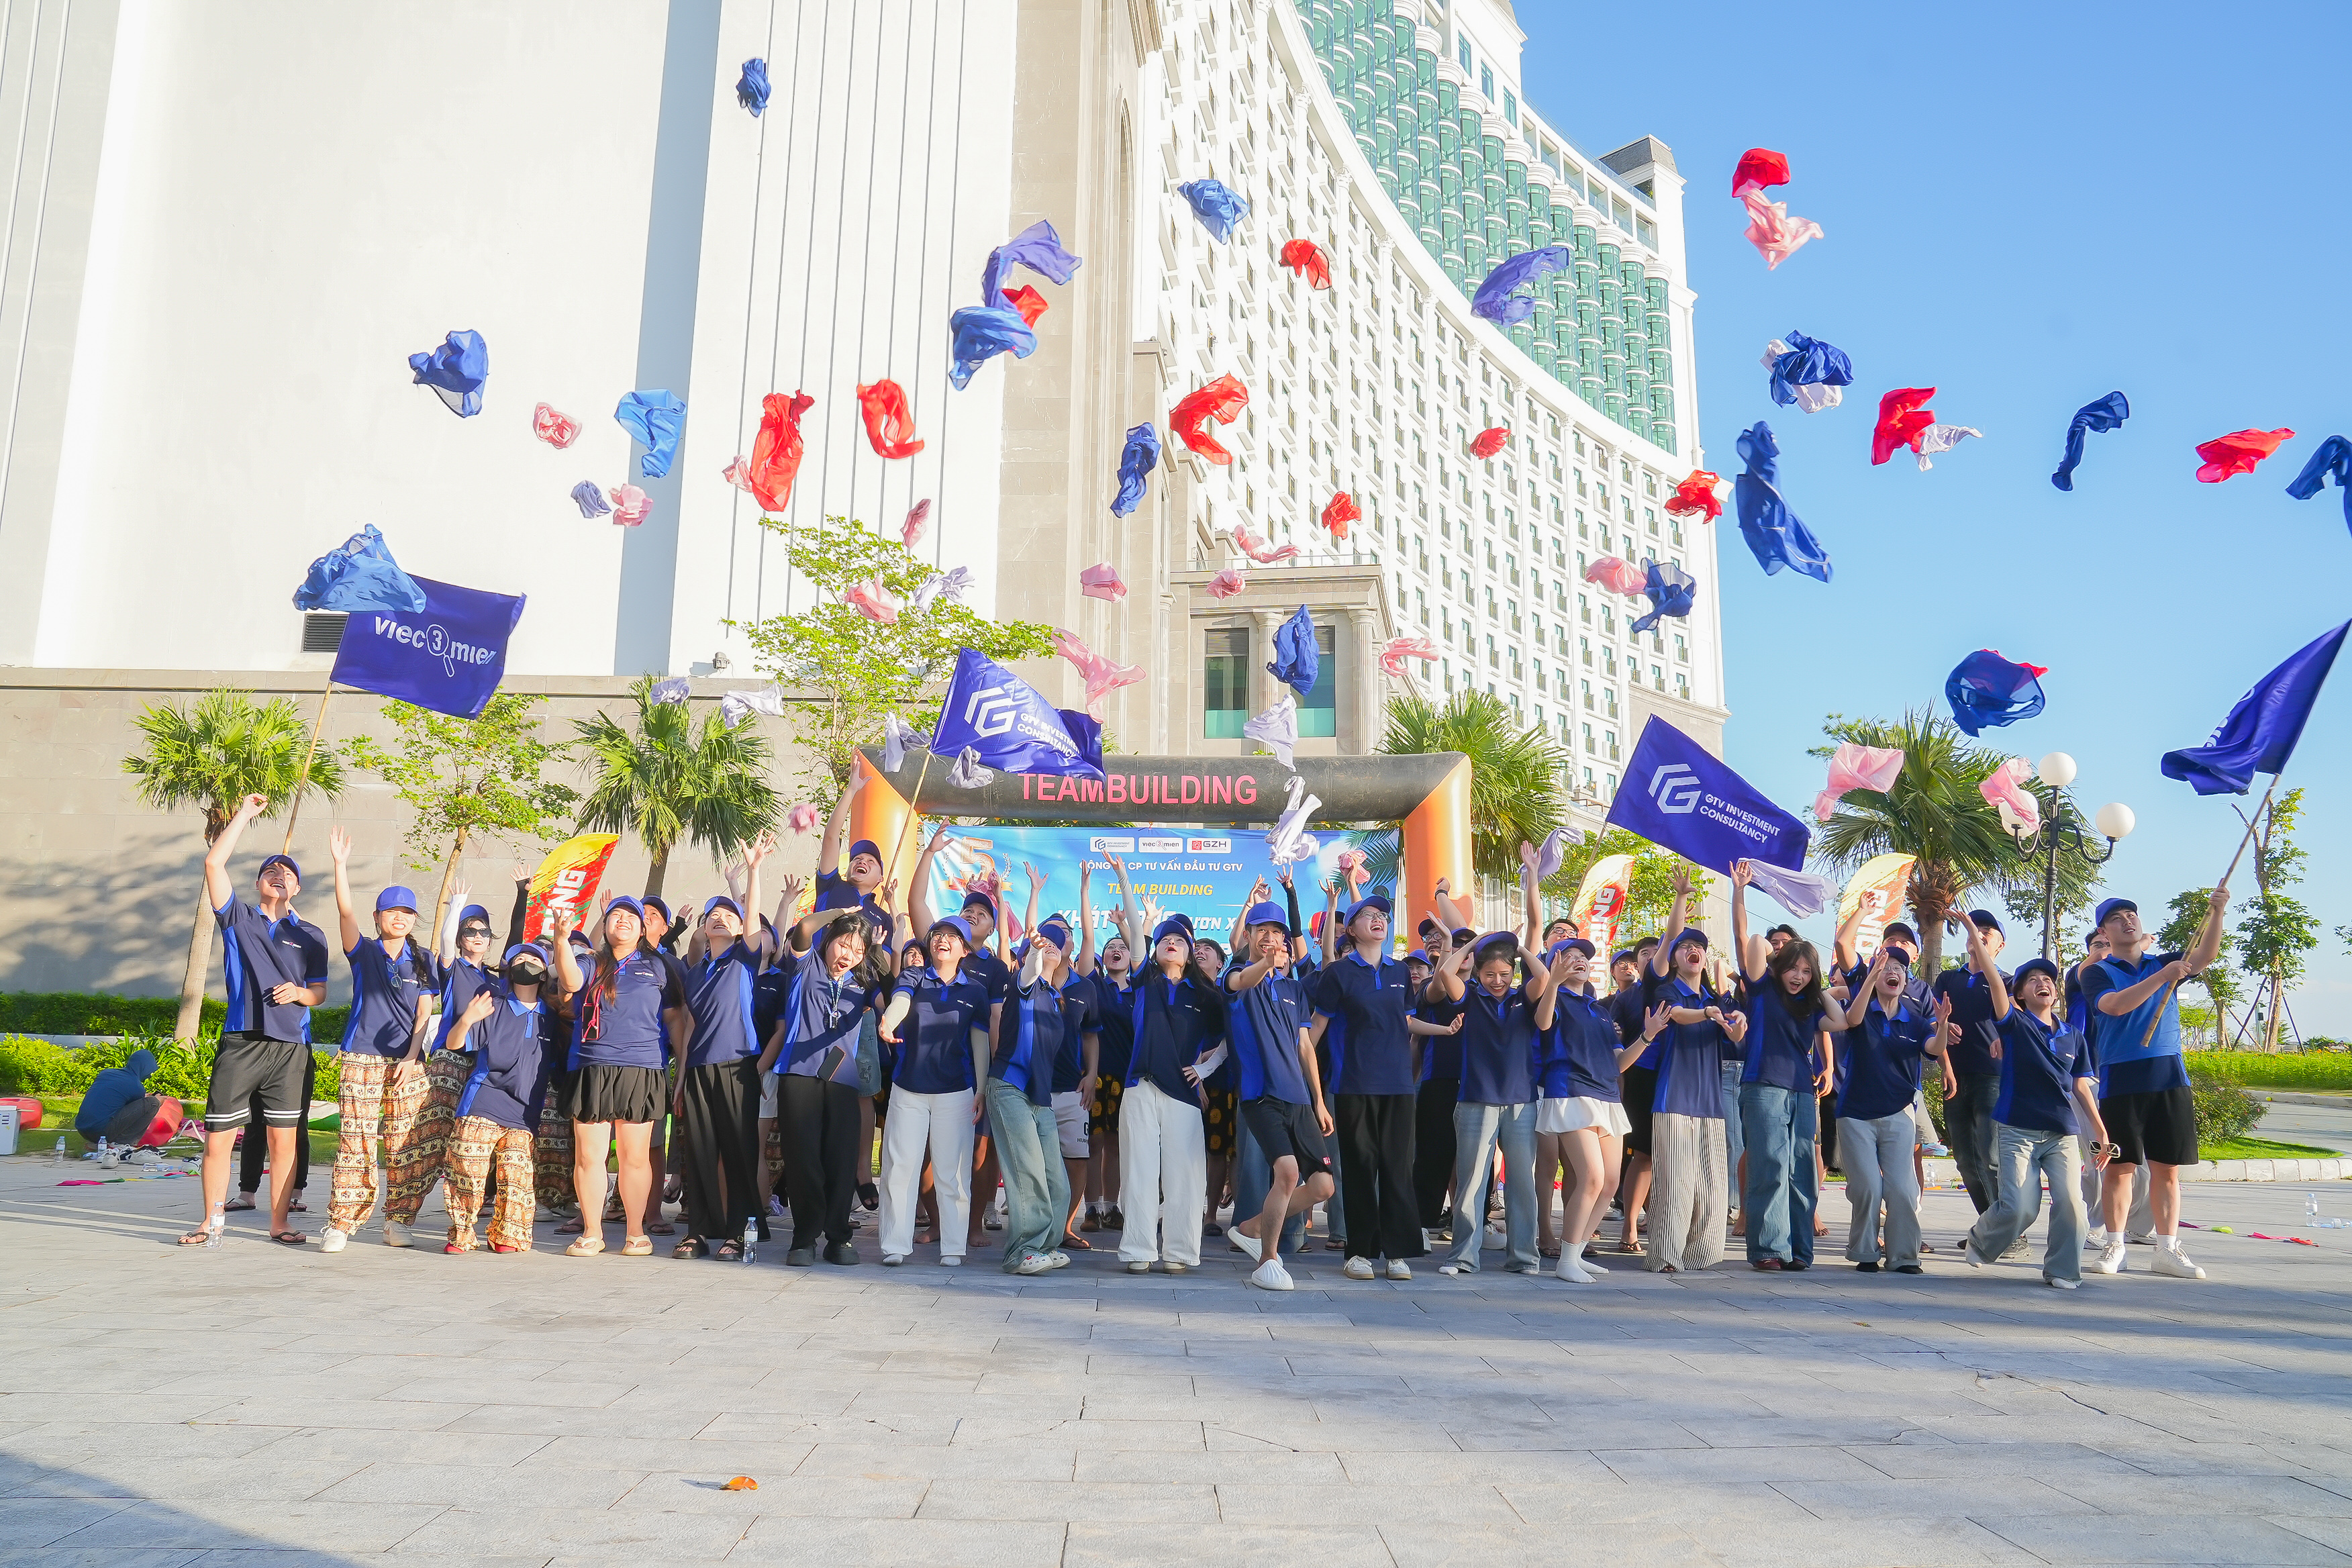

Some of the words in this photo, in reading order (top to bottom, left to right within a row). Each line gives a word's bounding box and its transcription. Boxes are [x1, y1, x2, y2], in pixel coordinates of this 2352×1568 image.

[1704, 793, 1726, 809] GTV
[1725, 803, 1781, 836] INVESTMENT
[1700, 805, 1769, 844] CONSULTANCY
[1128, 862, 1142, 871] CP
[1145, 861, 1158, 871] TƯ
[1159, 856, 1181, 871] VẤN
[1184, 859, 1206, 871] ĐẦU
[1208, 862, 1221, 871] TƯ
[1222, 863, 1243, 872] GTV
[1108, 883, 1146, 895] TEM
[1149, 883, 1214, 896] BUILDING
[1189, 916, 1222, 931] ƯƠN
